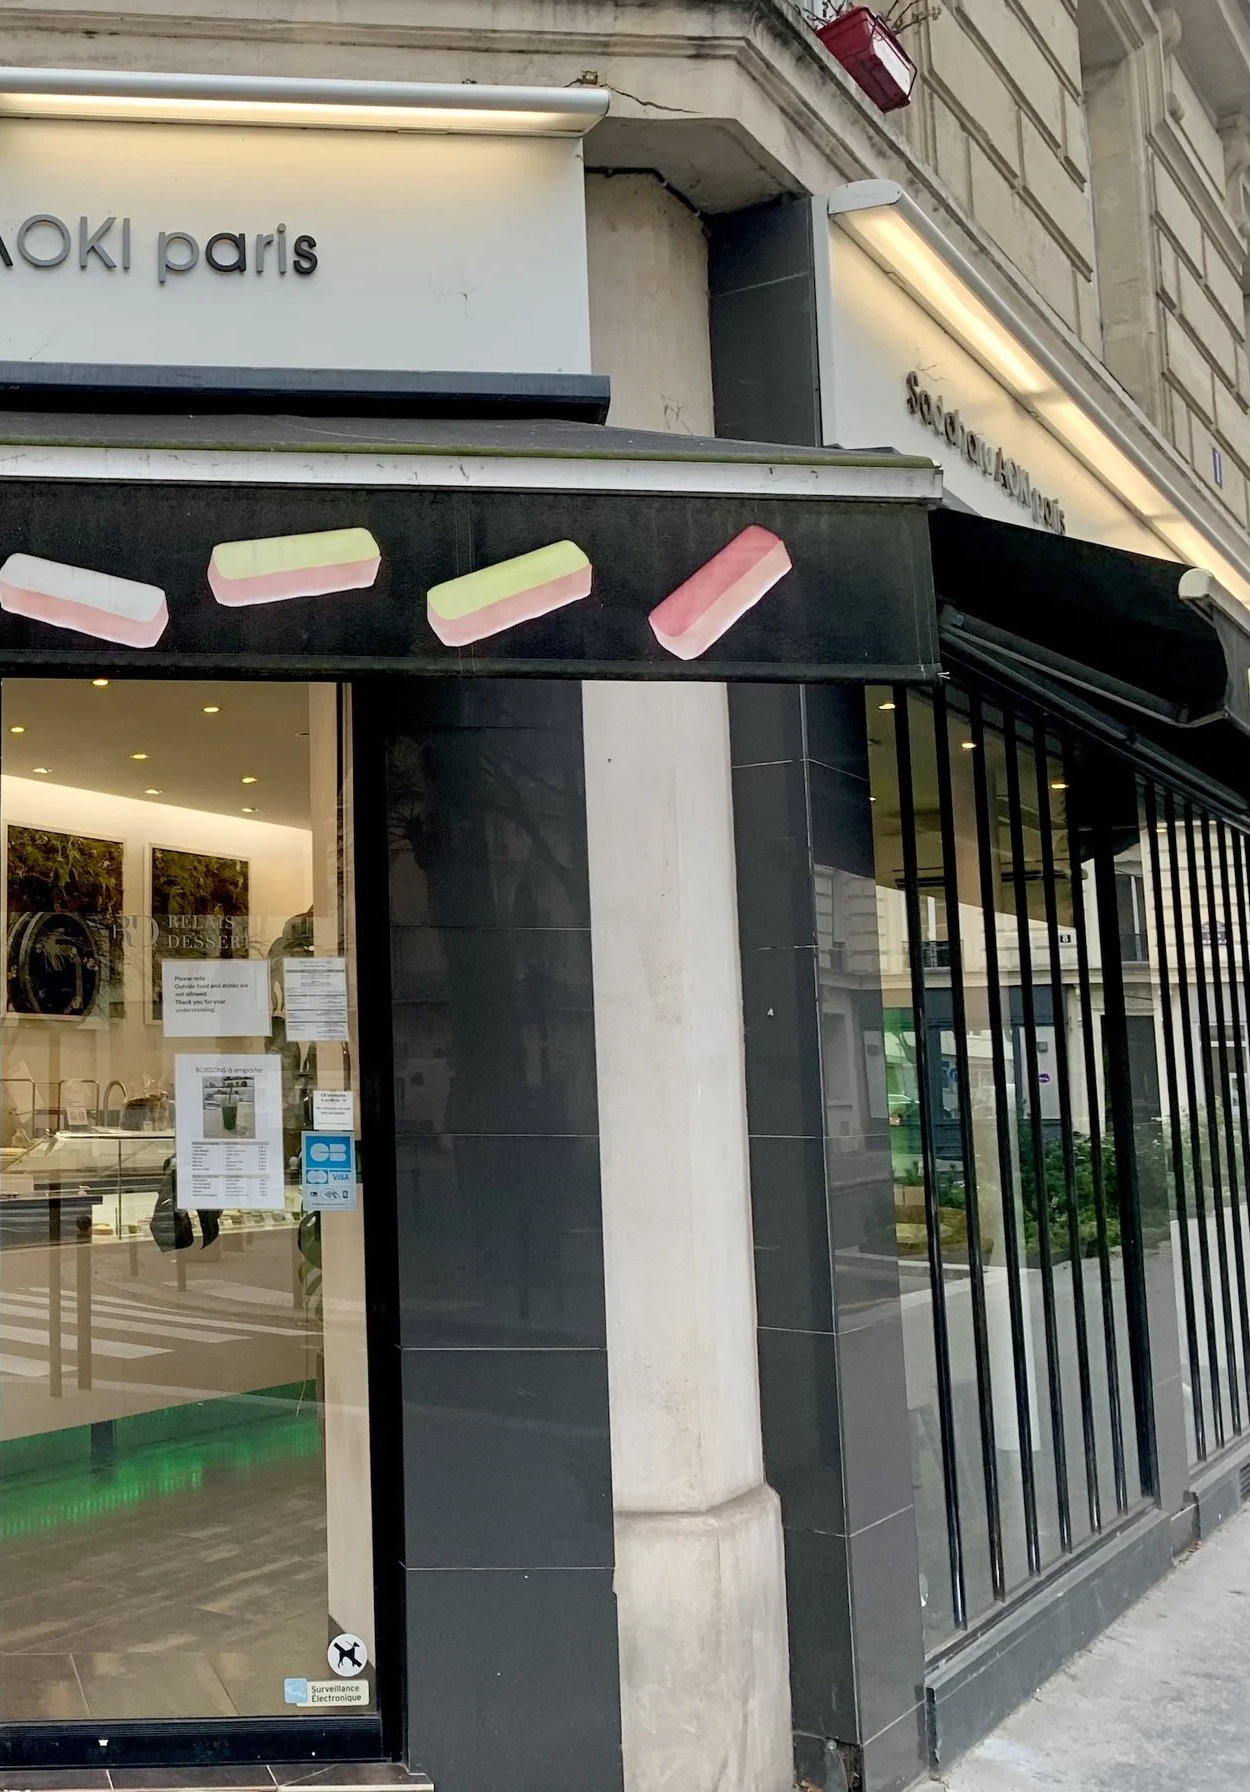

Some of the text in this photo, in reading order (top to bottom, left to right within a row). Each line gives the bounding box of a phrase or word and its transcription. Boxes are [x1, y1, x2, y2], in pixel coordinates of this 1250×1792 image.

[157, 222, 319, 285] paris
[167, 914, 235, 929] RELAIS
[332, 1173, 350, 1181] VISA
[311, 1685, 360, 1694] Surveillance
[311, 1693, 362, 1703] Électronique
